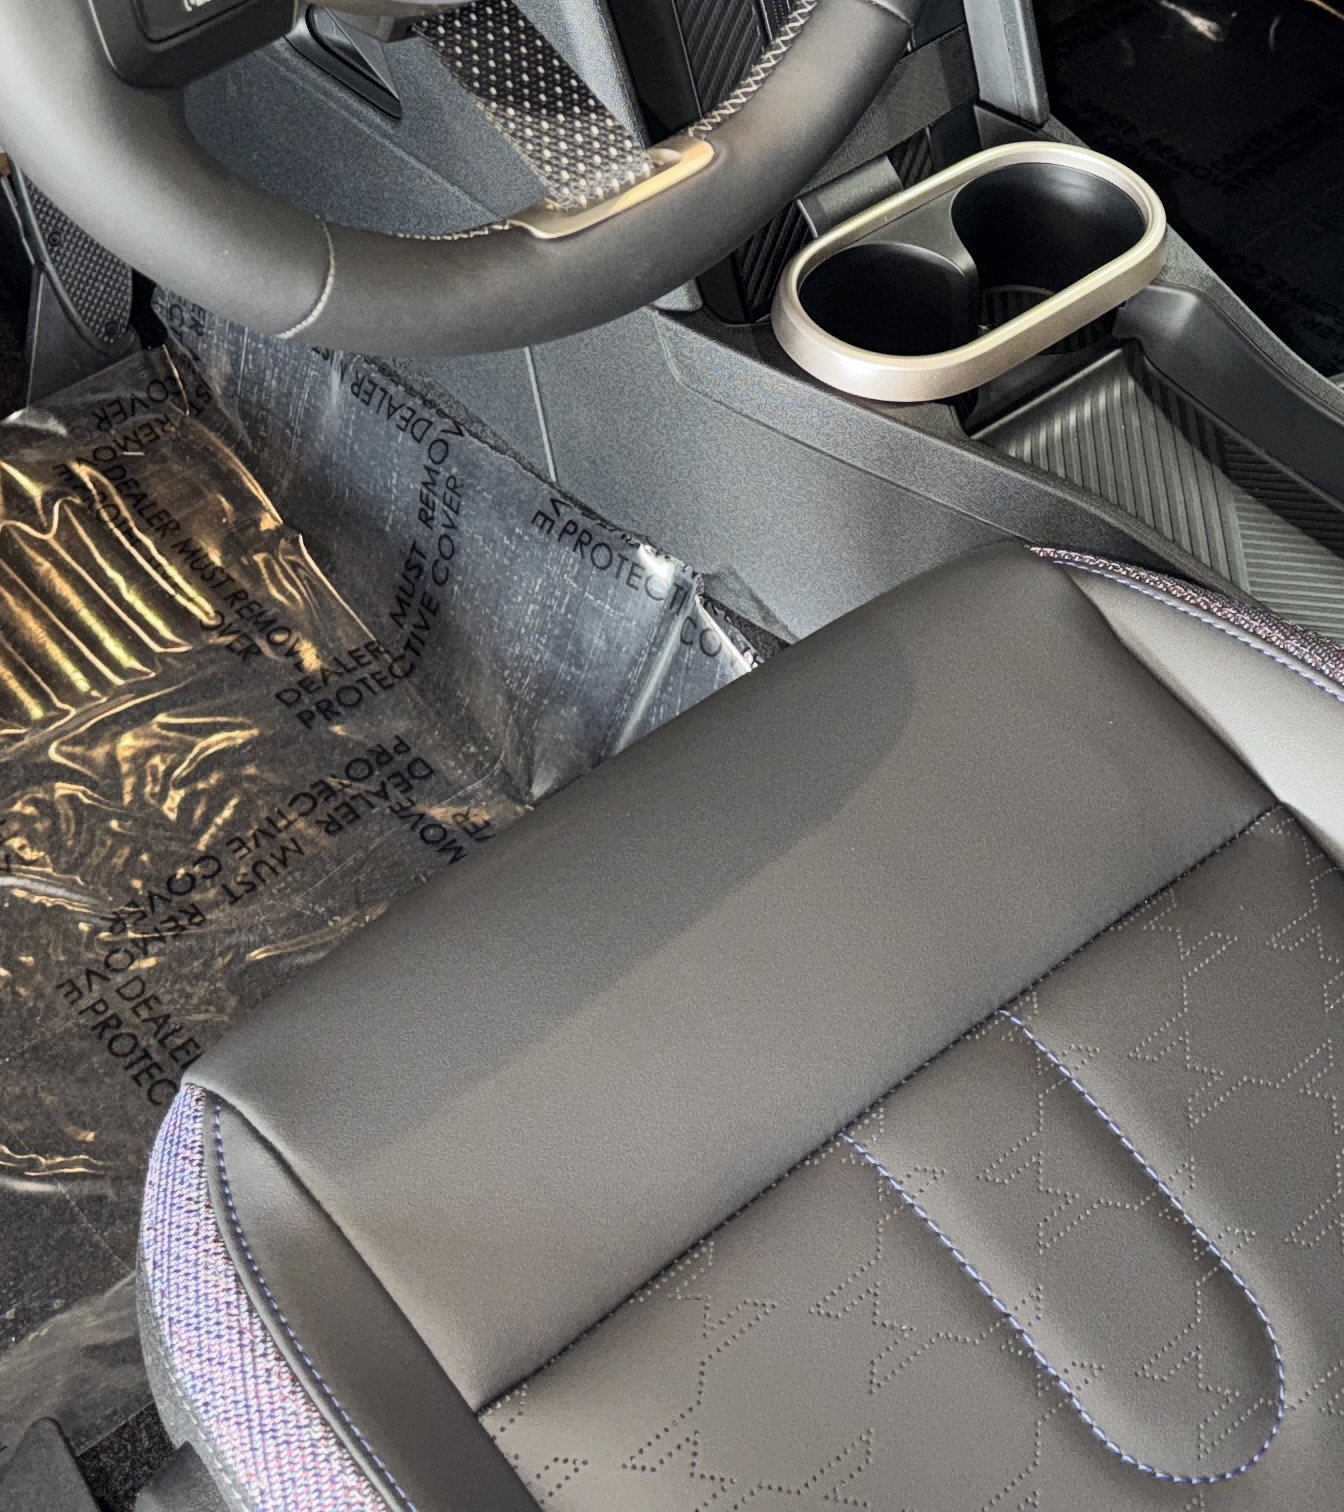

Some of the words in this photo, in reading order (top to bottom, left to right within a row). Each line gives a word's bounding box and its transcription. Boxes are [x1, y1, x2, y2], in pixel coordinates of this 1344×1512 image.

[349, 370, 434, 445] DEALER
[104, 464, 181, 538] DEALER
[170, 537, 237, 590] MUST
[274, 638, 385, 709] DEALER
[388, 539, 427, 630] MUST
[416, 421, 464, 531] REMOV
[557, 518, 690, 617] PROTECTI
[296, 590, 442, 730] PROTECTIVE
[431, 475, 465, 587] COVER
[225, 734, 412, 861] PROTECTIVE
[315, 755, 435, 838] DEALER
[387, 796, 469, 866] MOVE
[221, 837, 305, 905] MUST
[77, 997, 181, 1107] PROTEC
